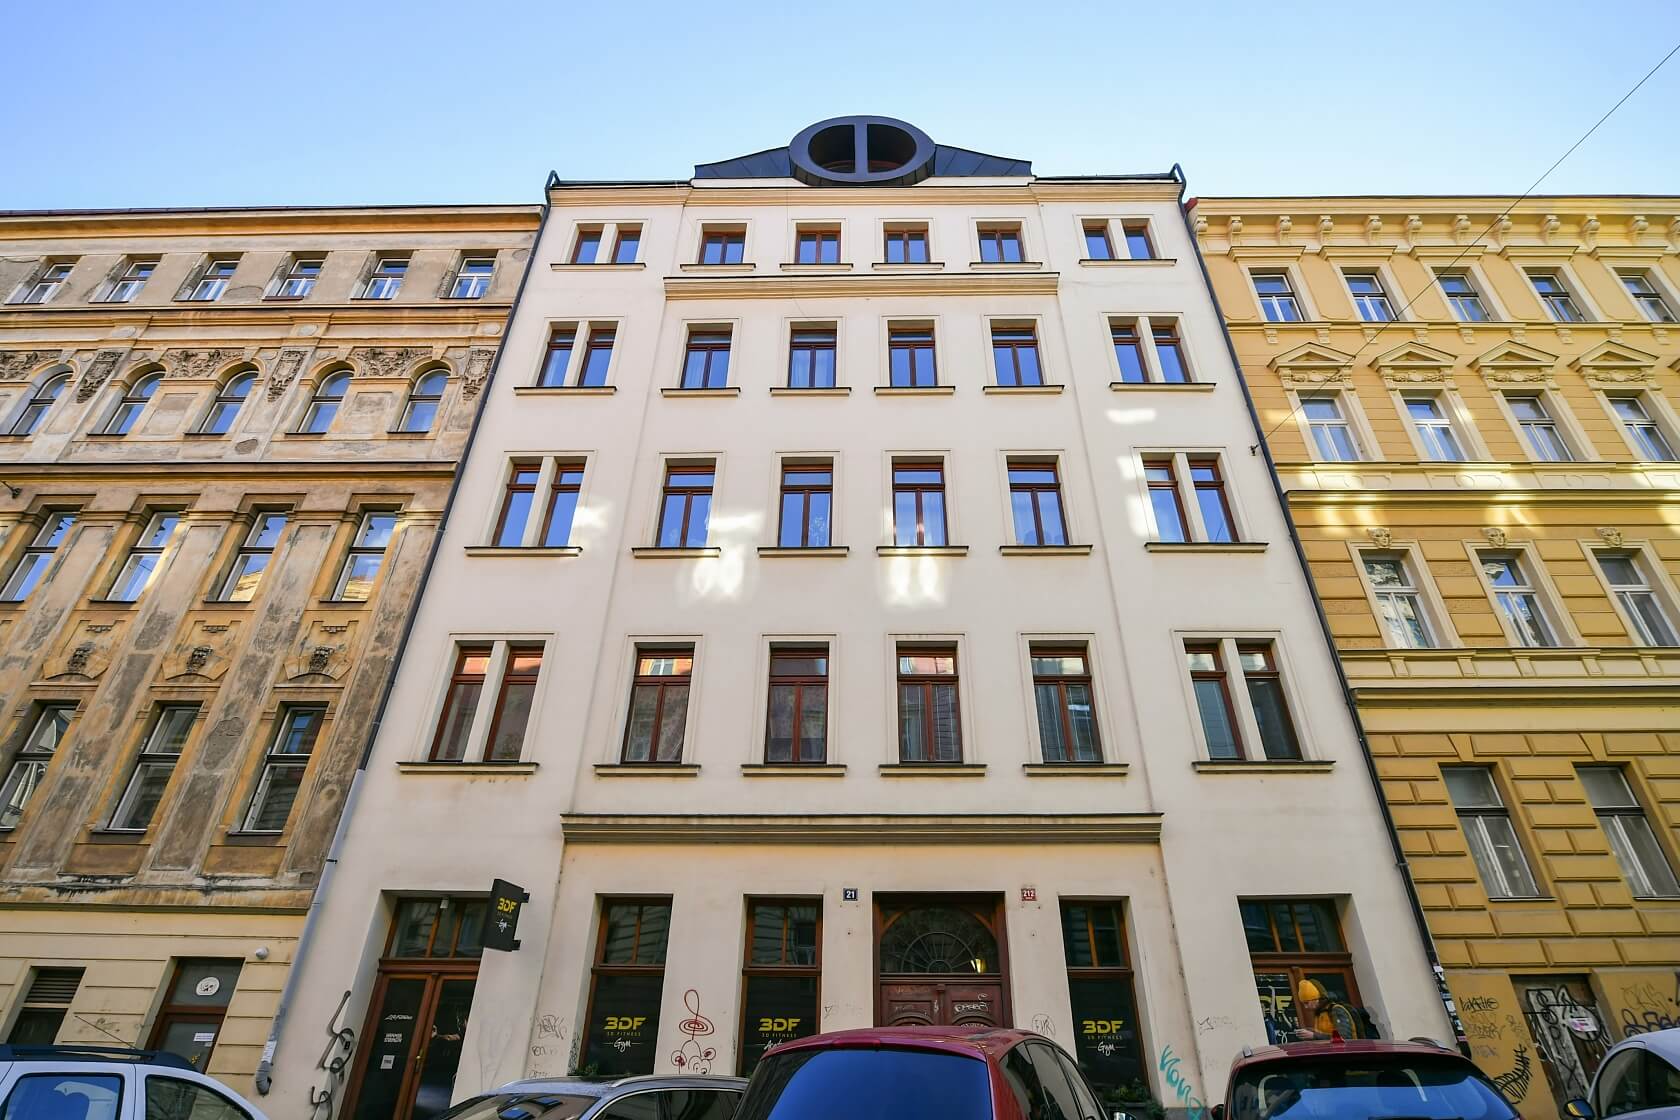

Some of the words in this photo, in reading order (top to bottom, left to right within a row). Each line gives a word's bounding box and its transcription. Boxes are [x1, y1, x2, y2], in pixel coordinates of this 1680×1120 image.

[846, 890, 855, 899] 21
[497, 897, 518, 913] 3DF
[604, 1016, 647, 1030] 3DF
[758, 1017, 801, 1031] 3DF
[1082, 1020, 1124, 1034] 3DF
[614, 1037, 632, 1053] Gym
[1097, 1041, 1116, 1057] Gym
